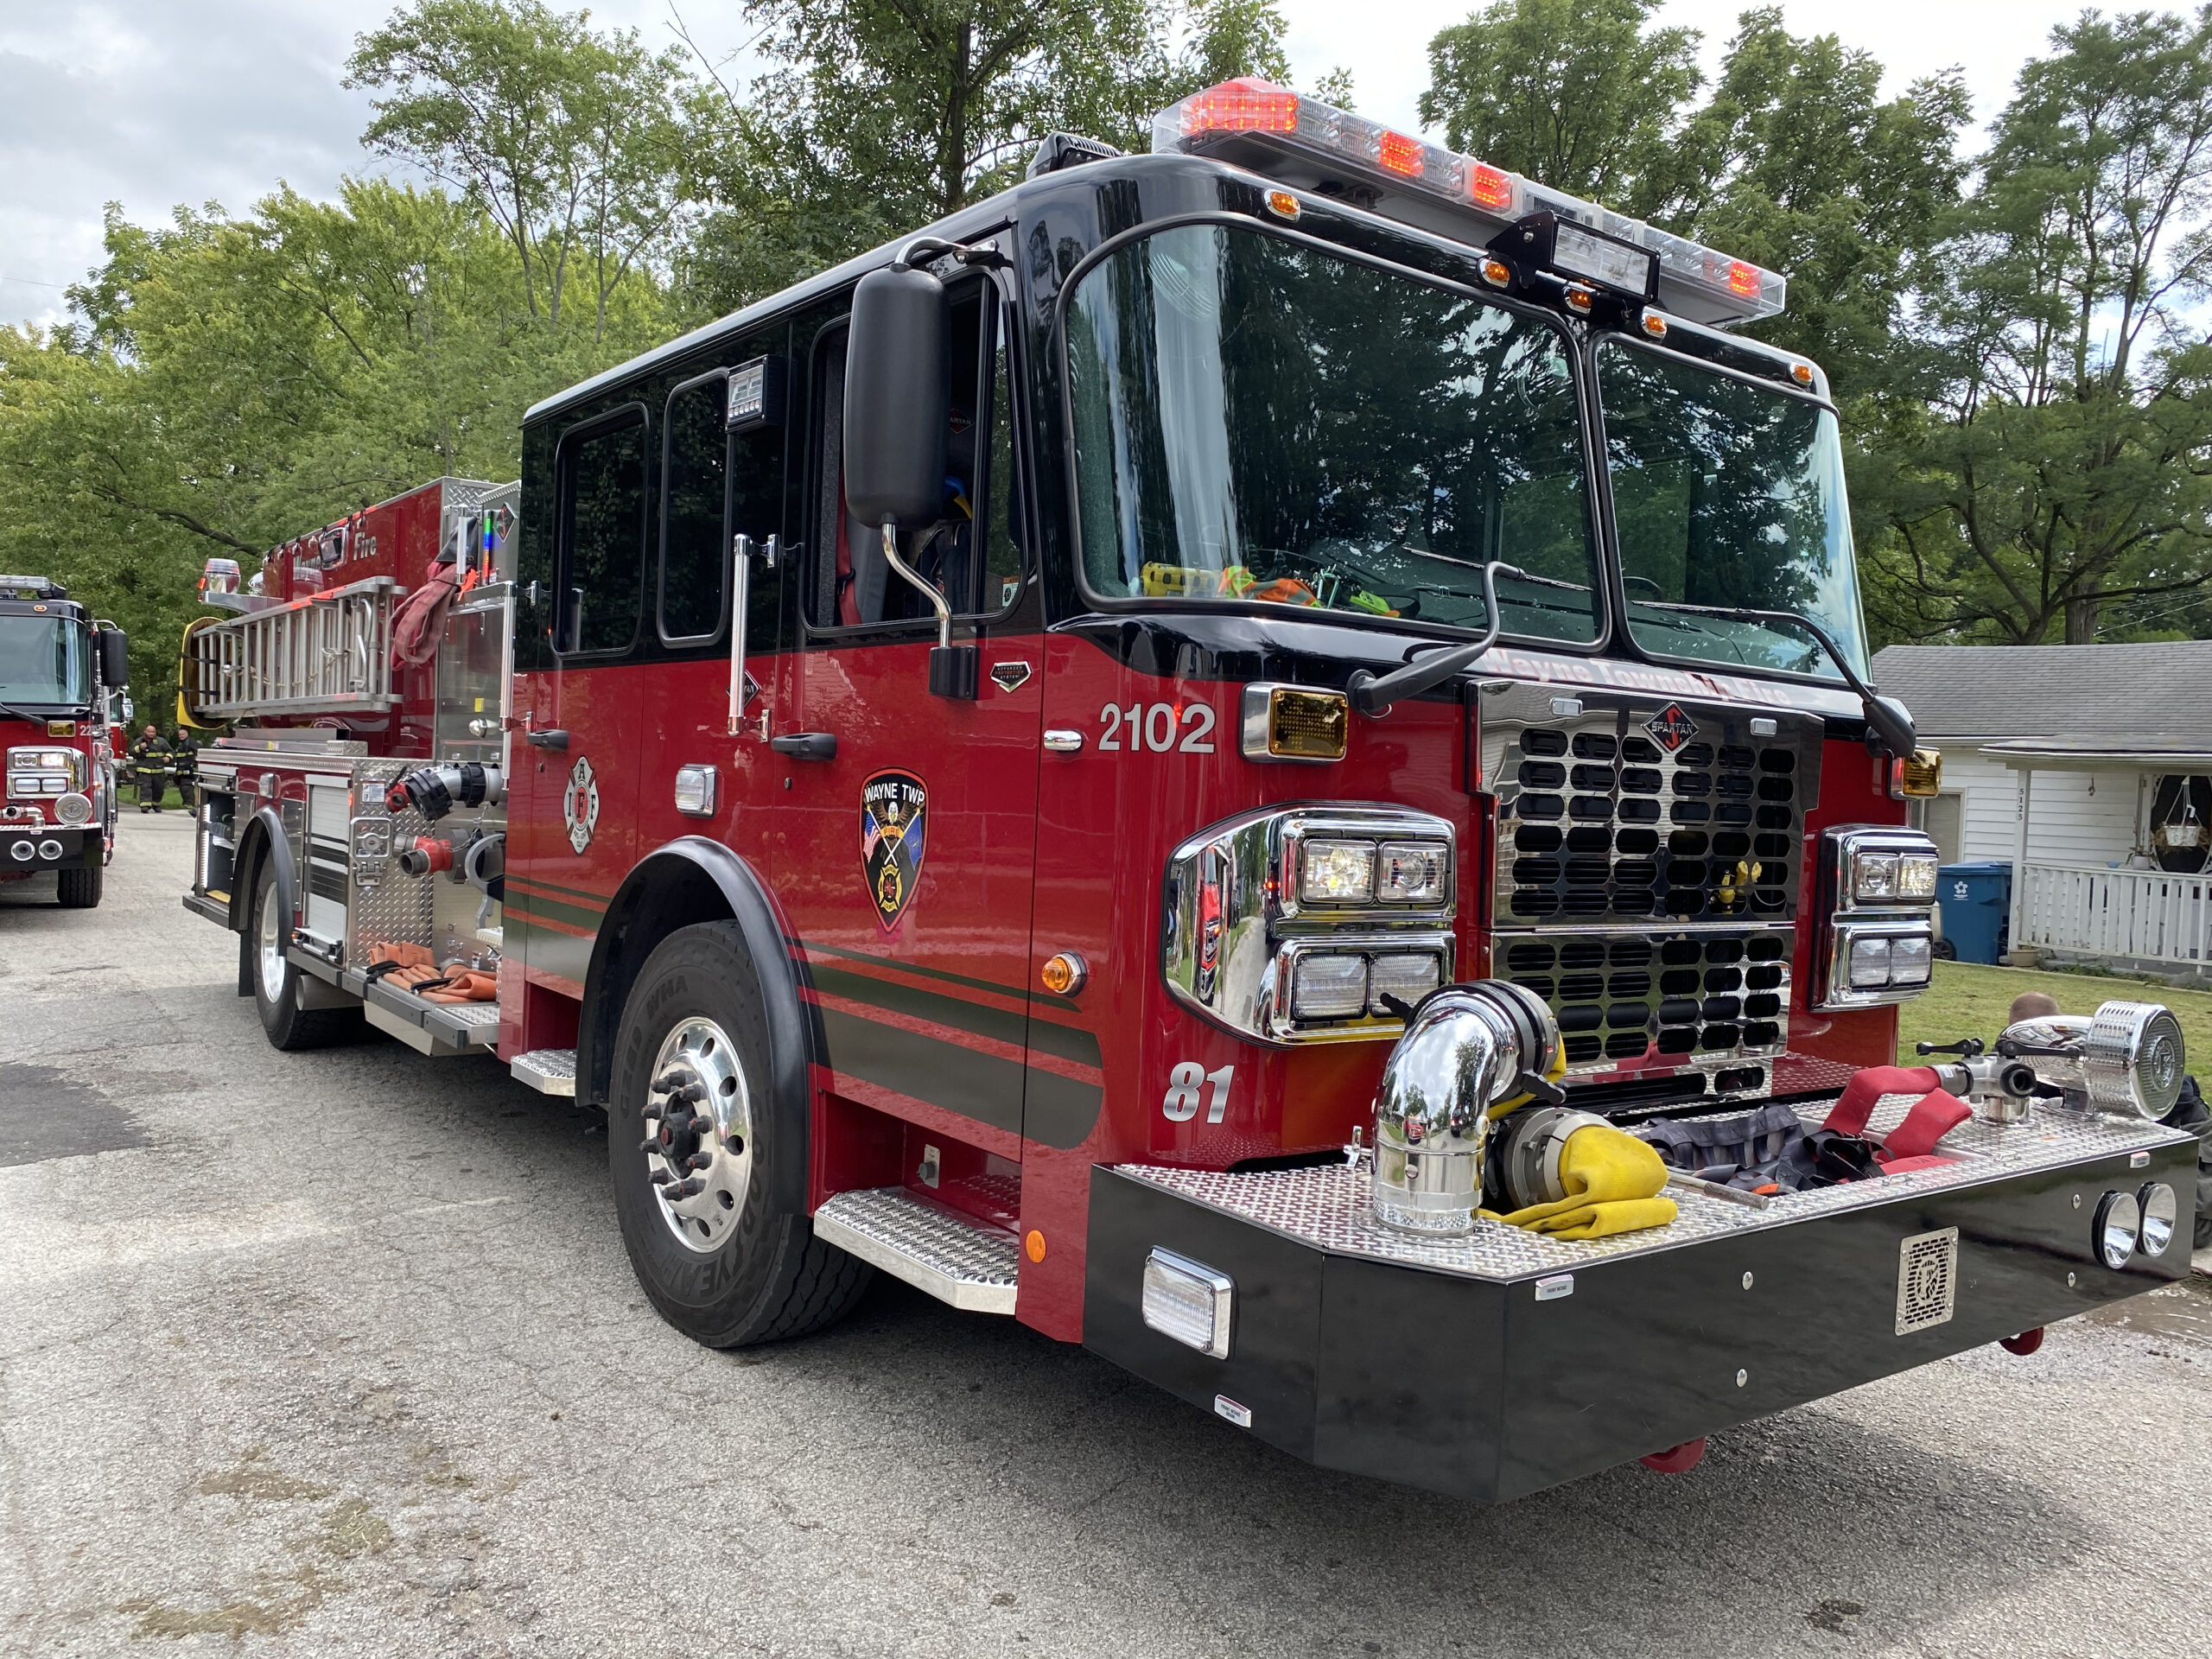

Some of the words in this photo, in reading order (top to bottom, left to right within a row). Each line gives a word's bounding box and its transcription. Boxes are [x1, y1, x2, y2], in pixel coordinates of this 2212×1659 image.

[353, 532, 377, 561] Fire
[1481, 649, 1594, 683] Wayne
[1589, 658, 1730, 702] Township
[1732, 677, 1793, 706] Fire
[1097, 702, 1216, 753] 2102
[1651, 721, 1694, 735] SPARTAN
[864, 782, 899, 804] WAYNE
[901, 784, 925, 806] TWP
[883, 827, 900, 837] FIRE
[1162, 1061, 1235, 1124] 81
